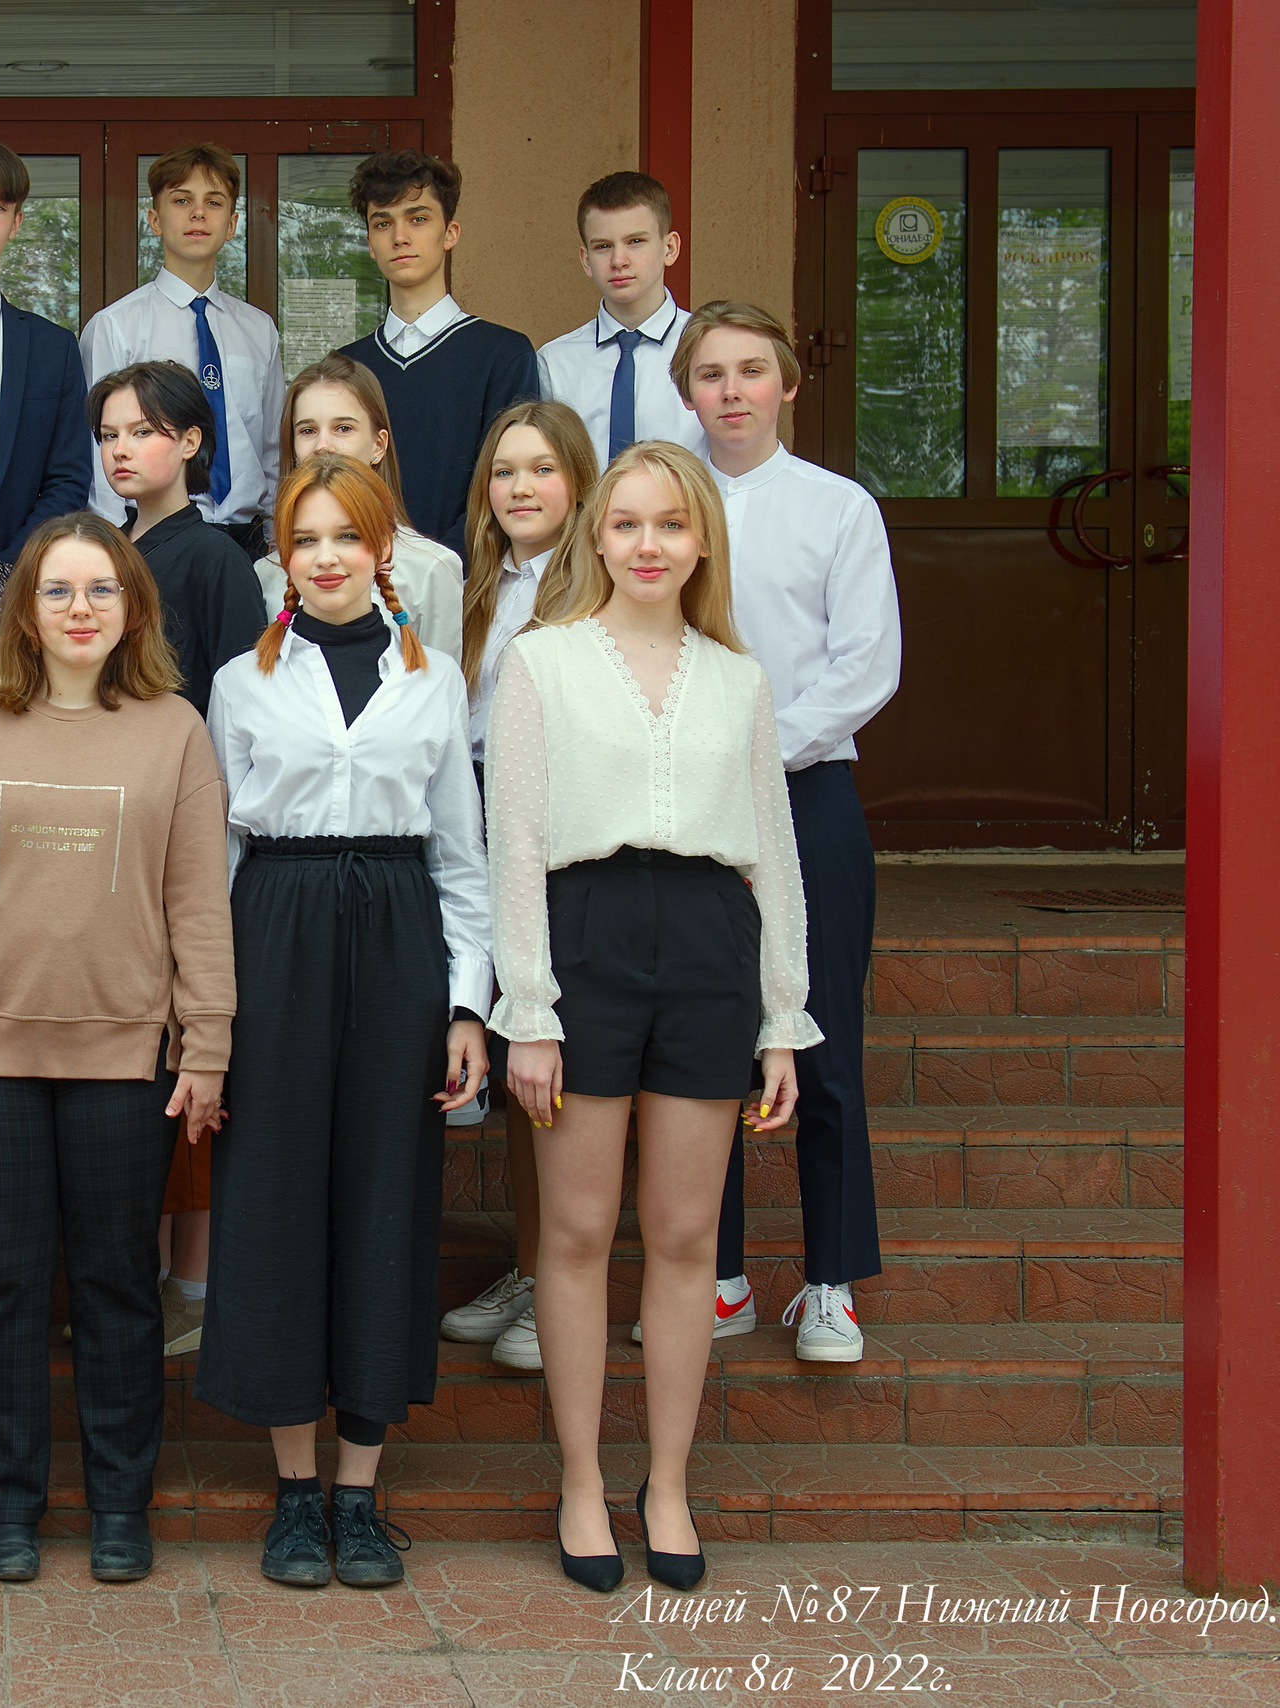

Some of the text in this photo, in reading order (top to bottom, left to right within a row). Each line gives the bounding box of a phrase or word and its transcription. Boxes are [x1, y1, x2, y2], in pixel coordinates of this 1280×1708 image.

[886, 233, 933, 244] ЮНИДЕФ
[1003, 250, 1097, 264] РОДНИЧОК
[27, 826, 56, 835] MUCH
[58, 828, 106, 837] INTERNET
[20, 840, 95, 851] SO LITTLE TIME
